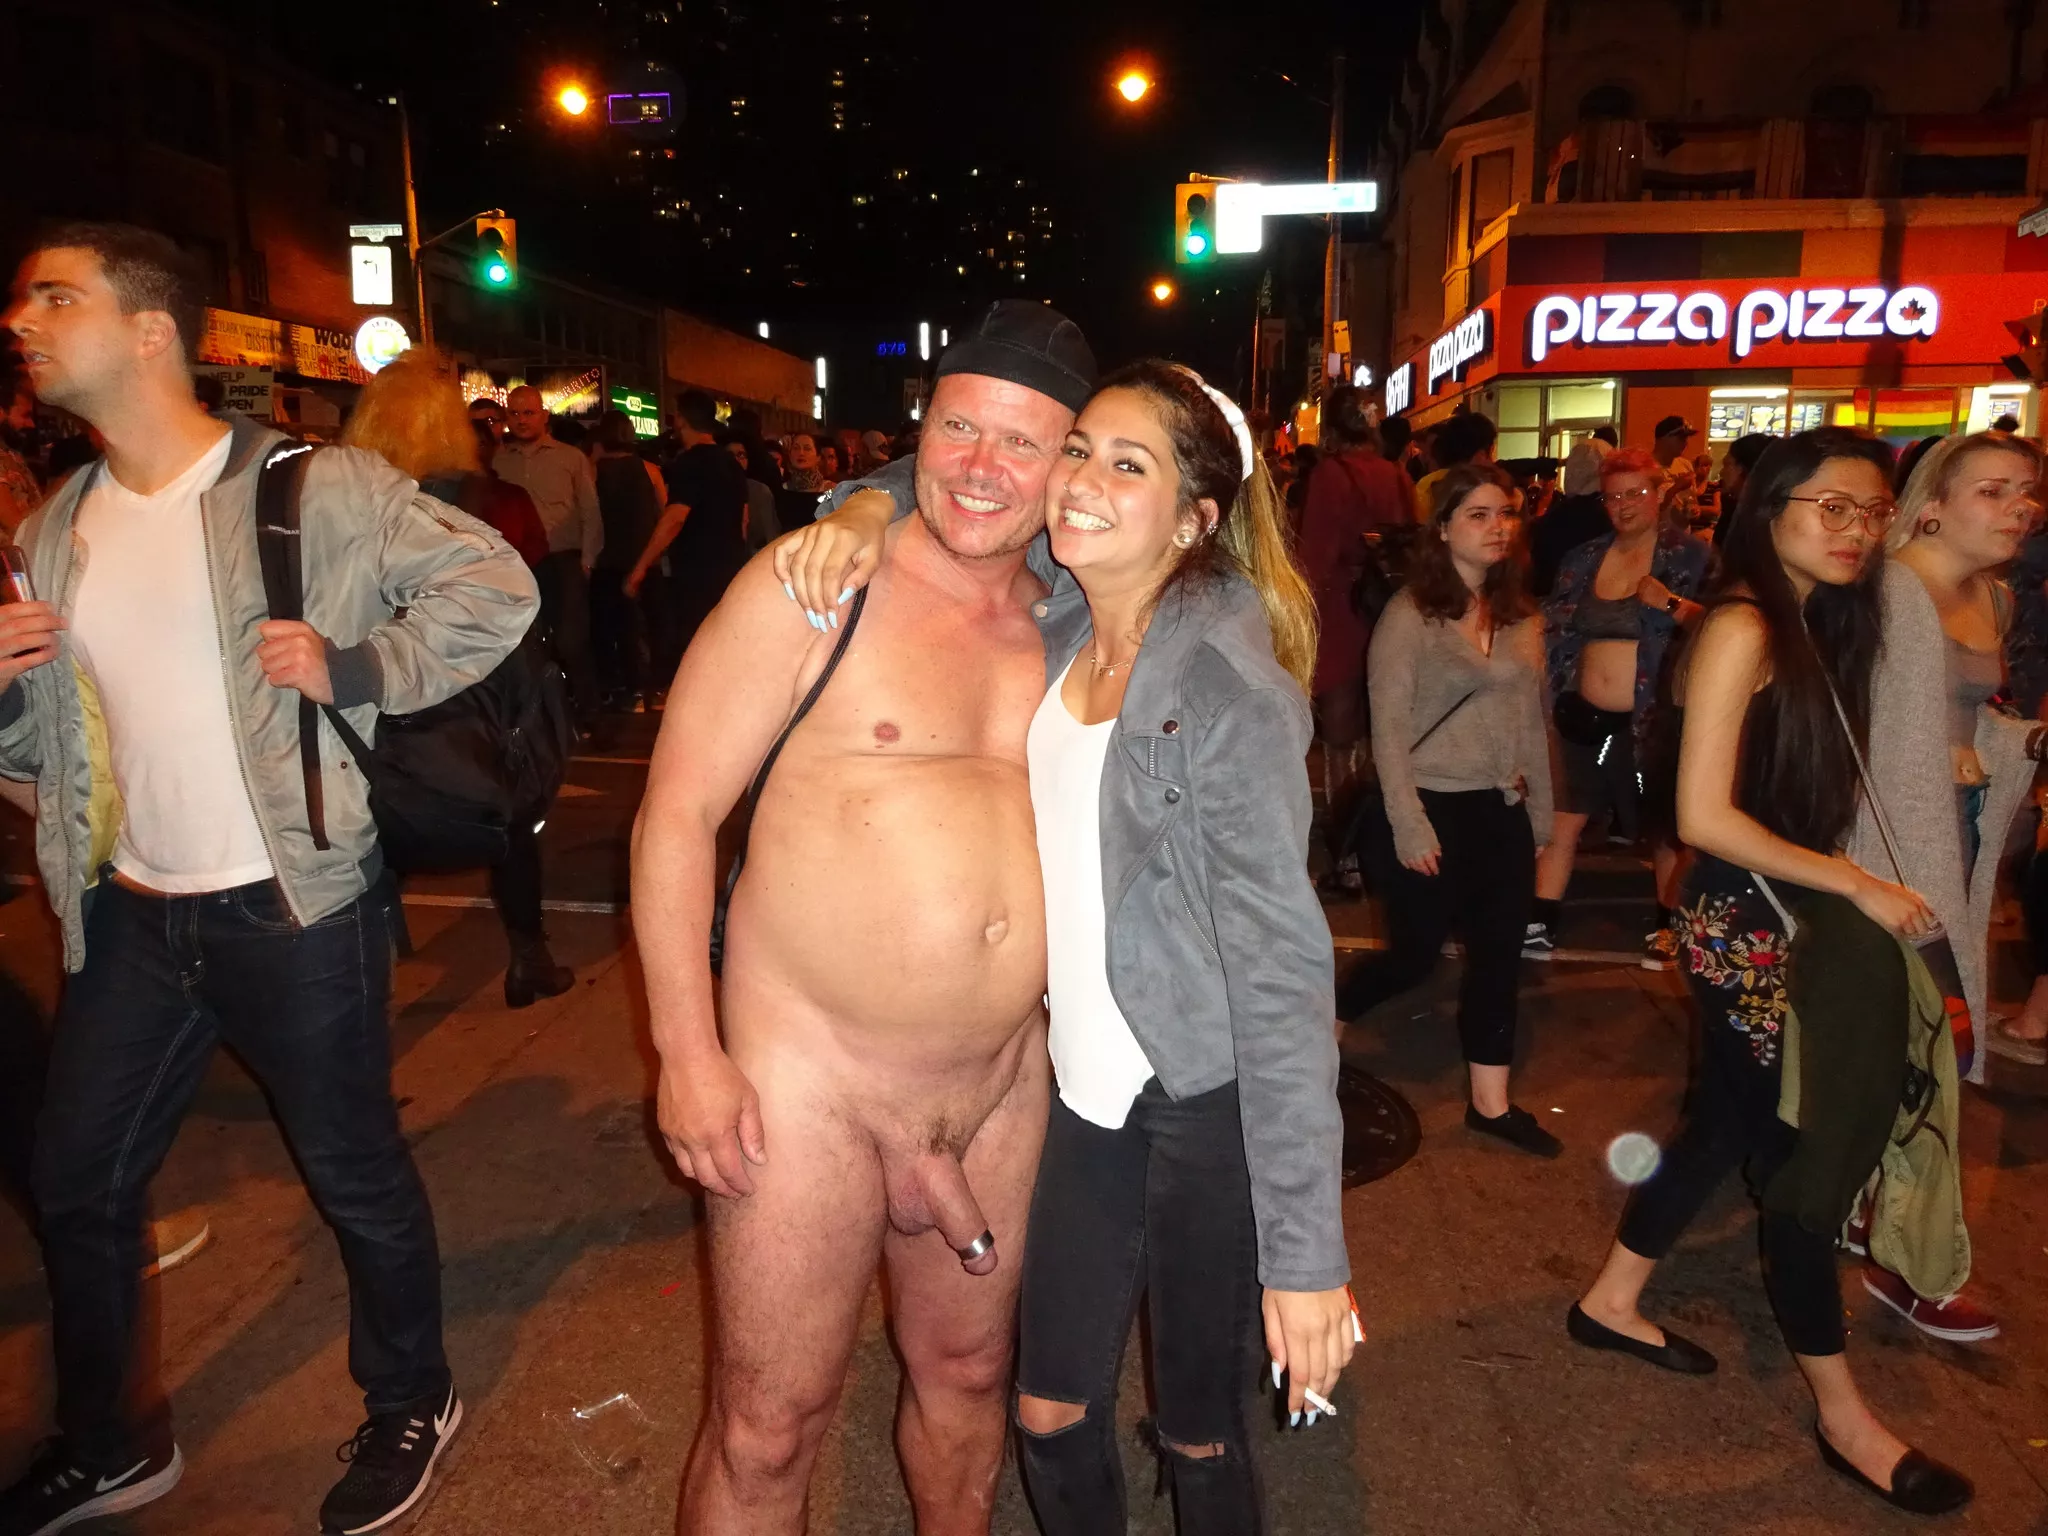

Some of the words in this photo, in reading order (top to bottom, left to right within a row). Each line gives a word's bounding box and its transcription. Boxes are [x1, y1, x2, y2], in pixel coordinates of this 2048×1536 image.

[1531, 292, 1727, 362] pizza
[1735, 287, 1938, 357] pizza
[229, 385, 269, 397] PRIDE
